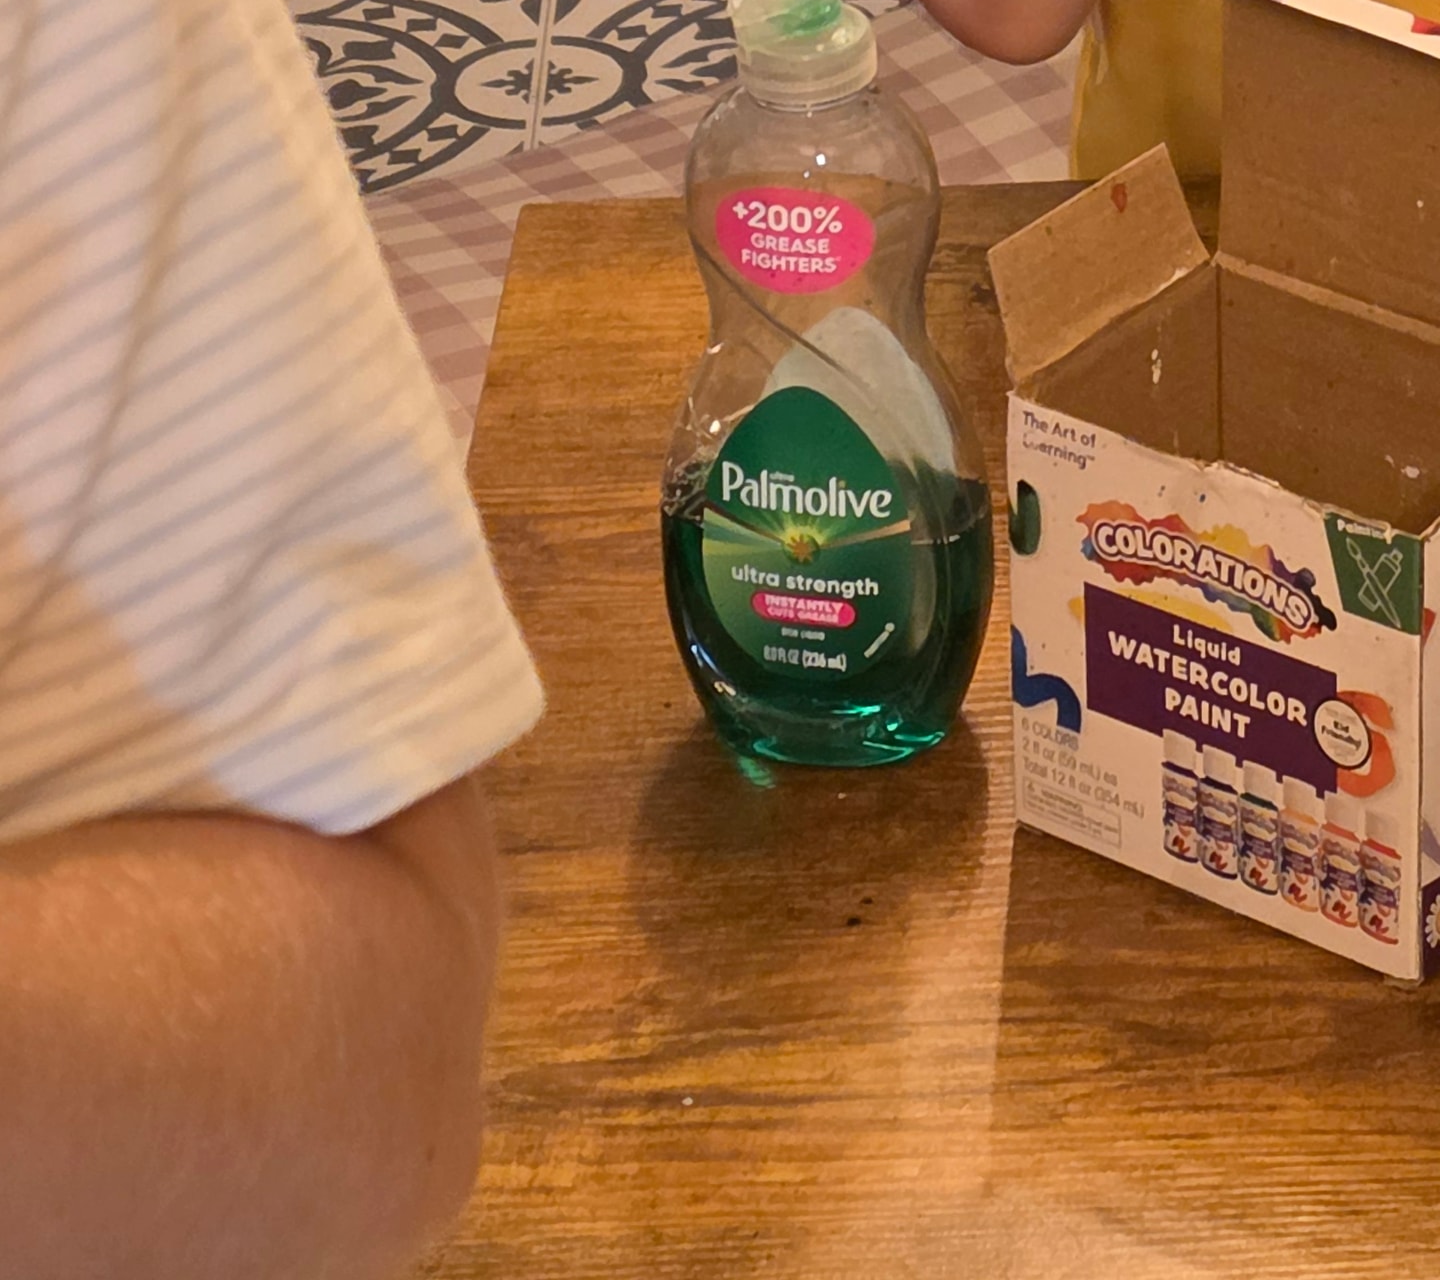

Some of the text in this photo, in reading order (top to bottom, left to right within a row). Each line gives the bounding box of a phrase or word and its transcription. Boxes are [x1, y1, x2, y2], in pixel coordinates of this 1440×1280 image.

[732, 201, 843, 234] +200%
[750, 232, 831, 254] GREASE
[741, 248, 838, 274] FIGHTERS
[1022, 409, 1096, 448] The Art of
[722, 460, 893, 519] Palmolive
[731, 564, 879, 599] ultra strength
[1095, 522, 1312, 629] COLORATIONS
[764, 593, 844, 615] INSTANTLY
[1172, 623, 1242, 666] Liquid
[1107, 630, 1308, 727] WATERCOLOR
[1164, 687, 1251, 739] PAINT
[1022, 736, 1030, 752] 2
[1051, 767, 1066, 786] 12
